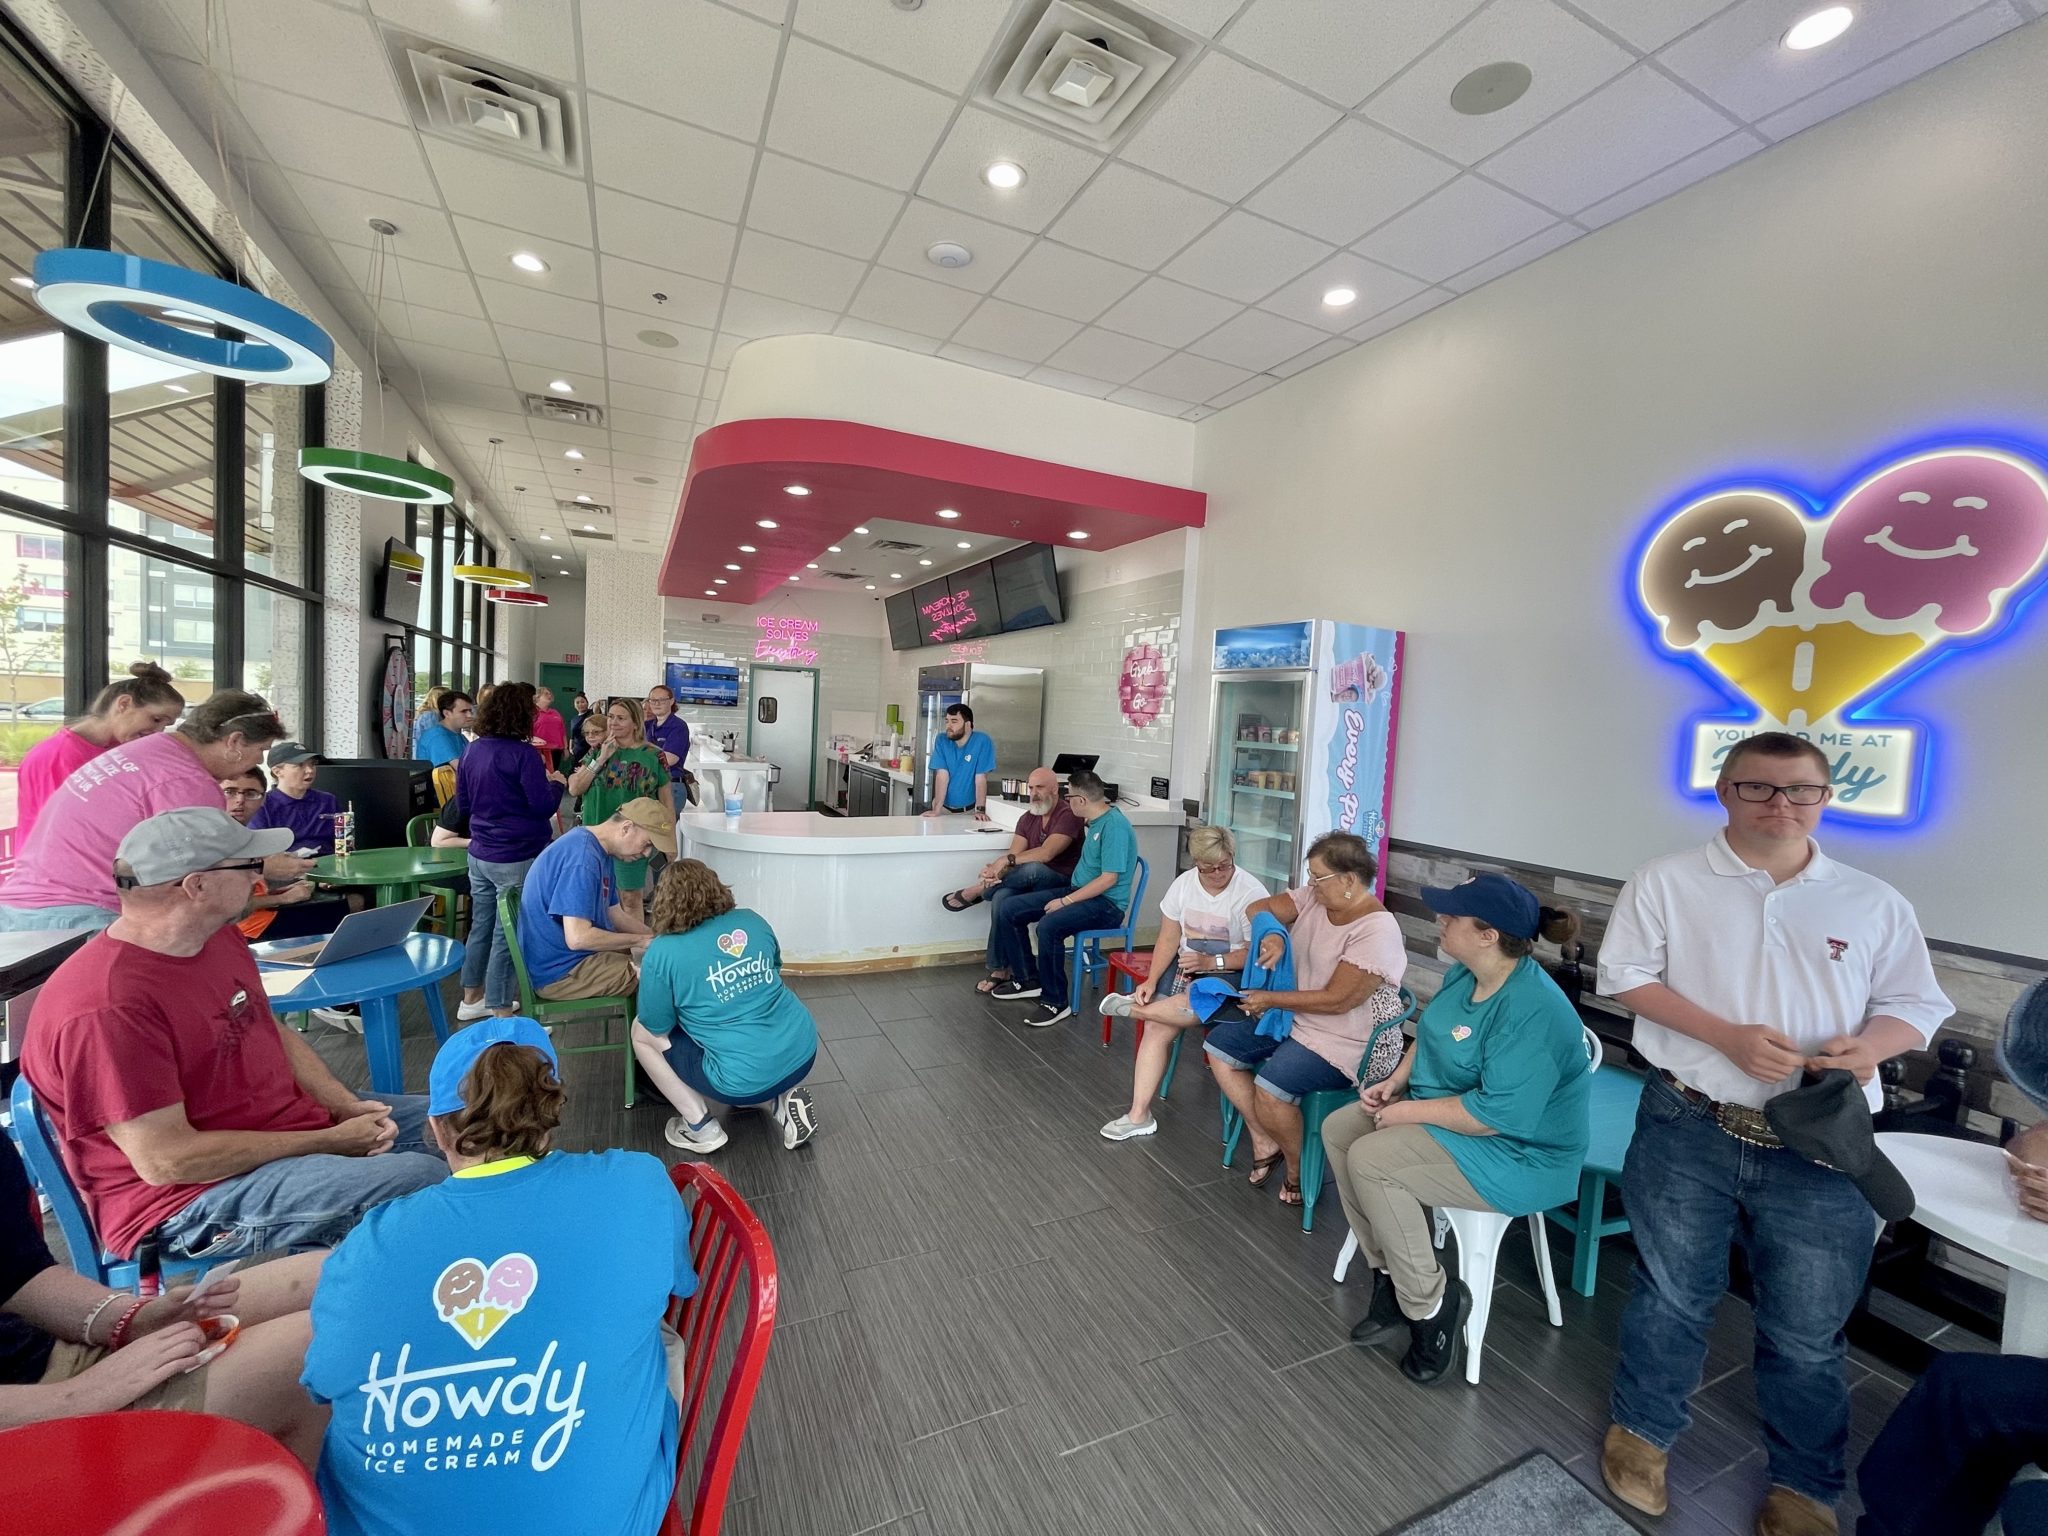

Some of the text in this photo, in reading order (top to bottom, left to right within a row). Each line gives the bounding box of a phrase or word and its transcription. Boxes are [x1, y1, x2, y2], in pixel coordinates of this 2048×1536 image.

[756, 617, 818, 632] ICE CREAM
[766, 629, 808, 641] SOLVES
[755, 639, 818, 665] Everything
[1130, 660, 1159, 678] Grab
[1132, 692, 1147, 710] Go
[1336, 708, 1364, 790] Every
[1820, 733, 1852, 746] ME
[1861, 734, 1892, 748] AT
[1367, 810, 1378, 848] Howd
[706, 951, 773, 993] Howdy
[717, 973, 762, 999] HOMEMADE
[720, 978, 763, 1004] ICE CREAM
[359, 1340, 588, 1472] Howdy
[366, 1429, 525, 1457] HOMEMADE
[365, 1449, 521, 1473] ICE CREAM
